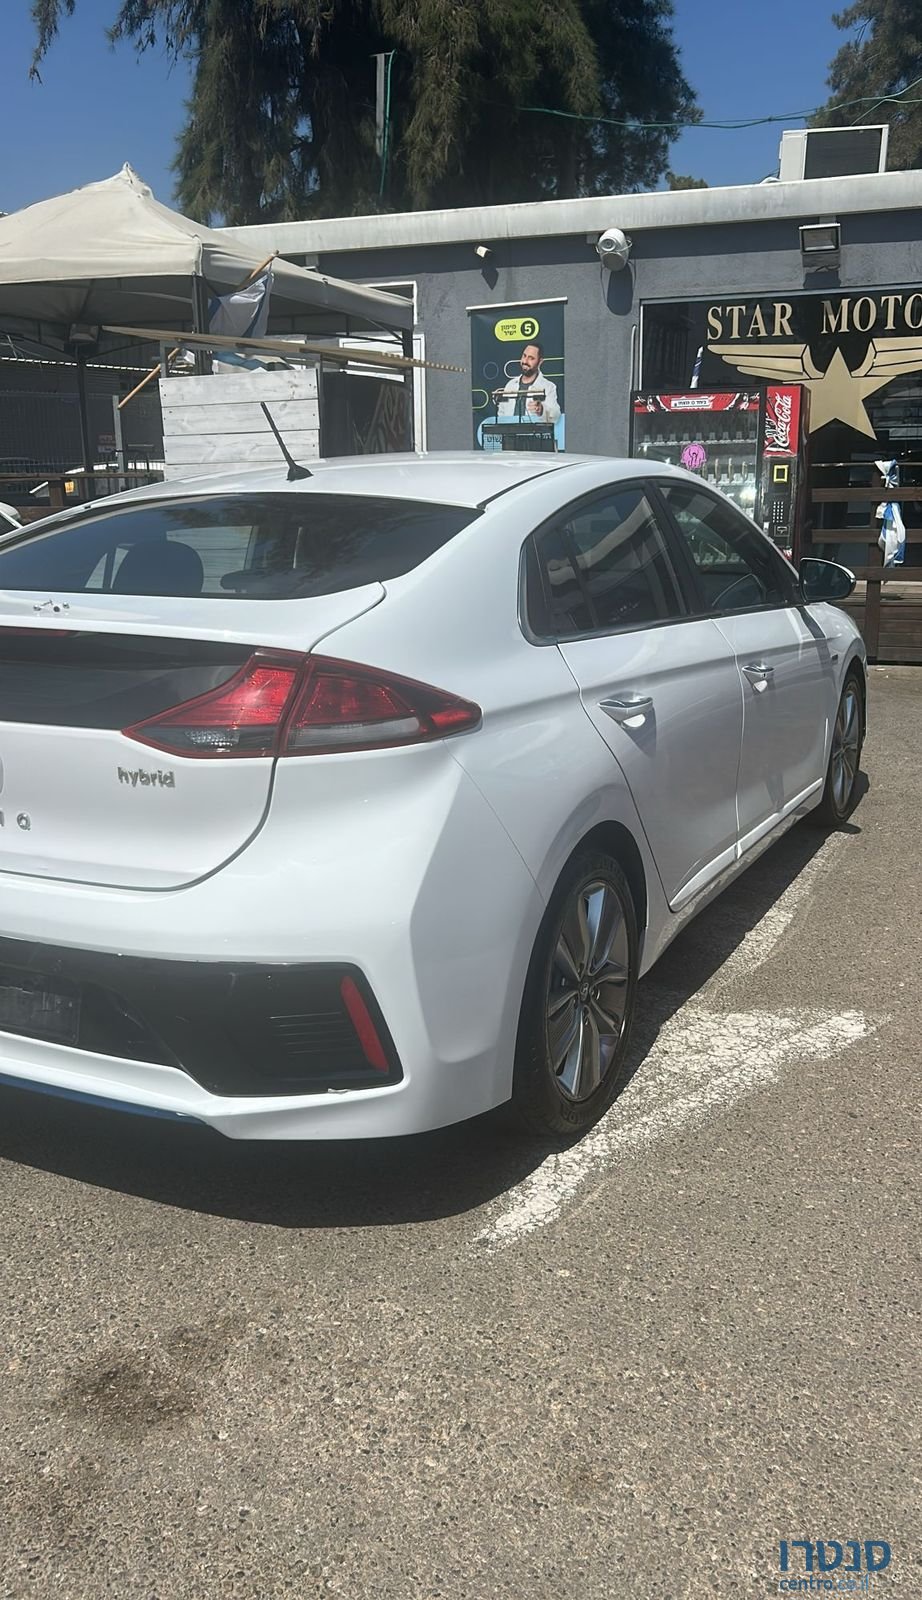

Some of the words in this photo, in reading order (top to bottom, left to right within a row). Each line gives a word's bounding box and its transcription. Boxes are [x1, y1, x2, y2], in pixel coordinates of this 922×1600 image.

[500, 324, 517, 332] מימון
[524, 323, 532, 335] 5
[707, 303, 794, 340] STAR
[117, 766, 175, 788] hybrid
